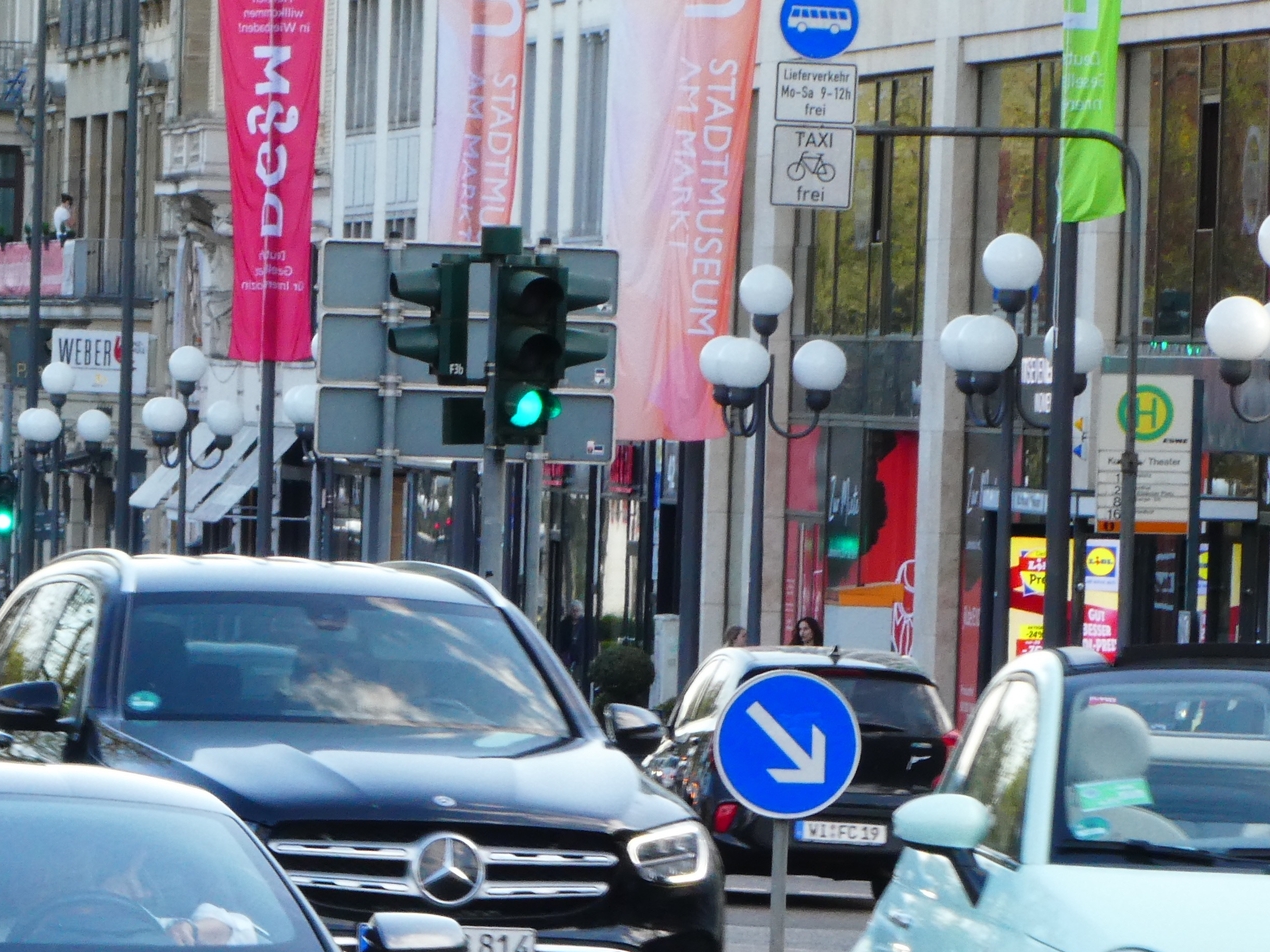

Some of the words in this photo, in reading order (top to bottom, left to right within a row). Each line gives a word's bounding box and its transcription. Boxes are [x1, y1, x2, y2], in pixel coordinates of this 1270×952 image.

[784, 69, 850, 83] Lieferverkehr
[676, 57, 702, 113] AM
[781, 86, 814, 99] Mo-Sa
[820, 87, 851, 100] 9-12h
[466, 73, 486, 119] AM
[805, 103, 826, 116] frei
[795, 131, 833, 149] TAXI
[481, 73, 517, 226] STADTMU
[458, 134, 483, 241] MARKT
[669, 130, 697, 255] MARKT
[797, 186, 825, 202] frei
[687, 58, 739, 336] STADTMUSEUM
[59, 338, 112, 366] WEBER
[449, 363, 464, 375] F3b
[1149, 457, 1181, 466] Theater
[1114, 485, 1122, 495] 2
[1108, 509, 1122, 520] 16
[1088, 609, 1106, 622] GUT
[809, 823, 826, 838] WI
[861, 826, 880, 840] 19
